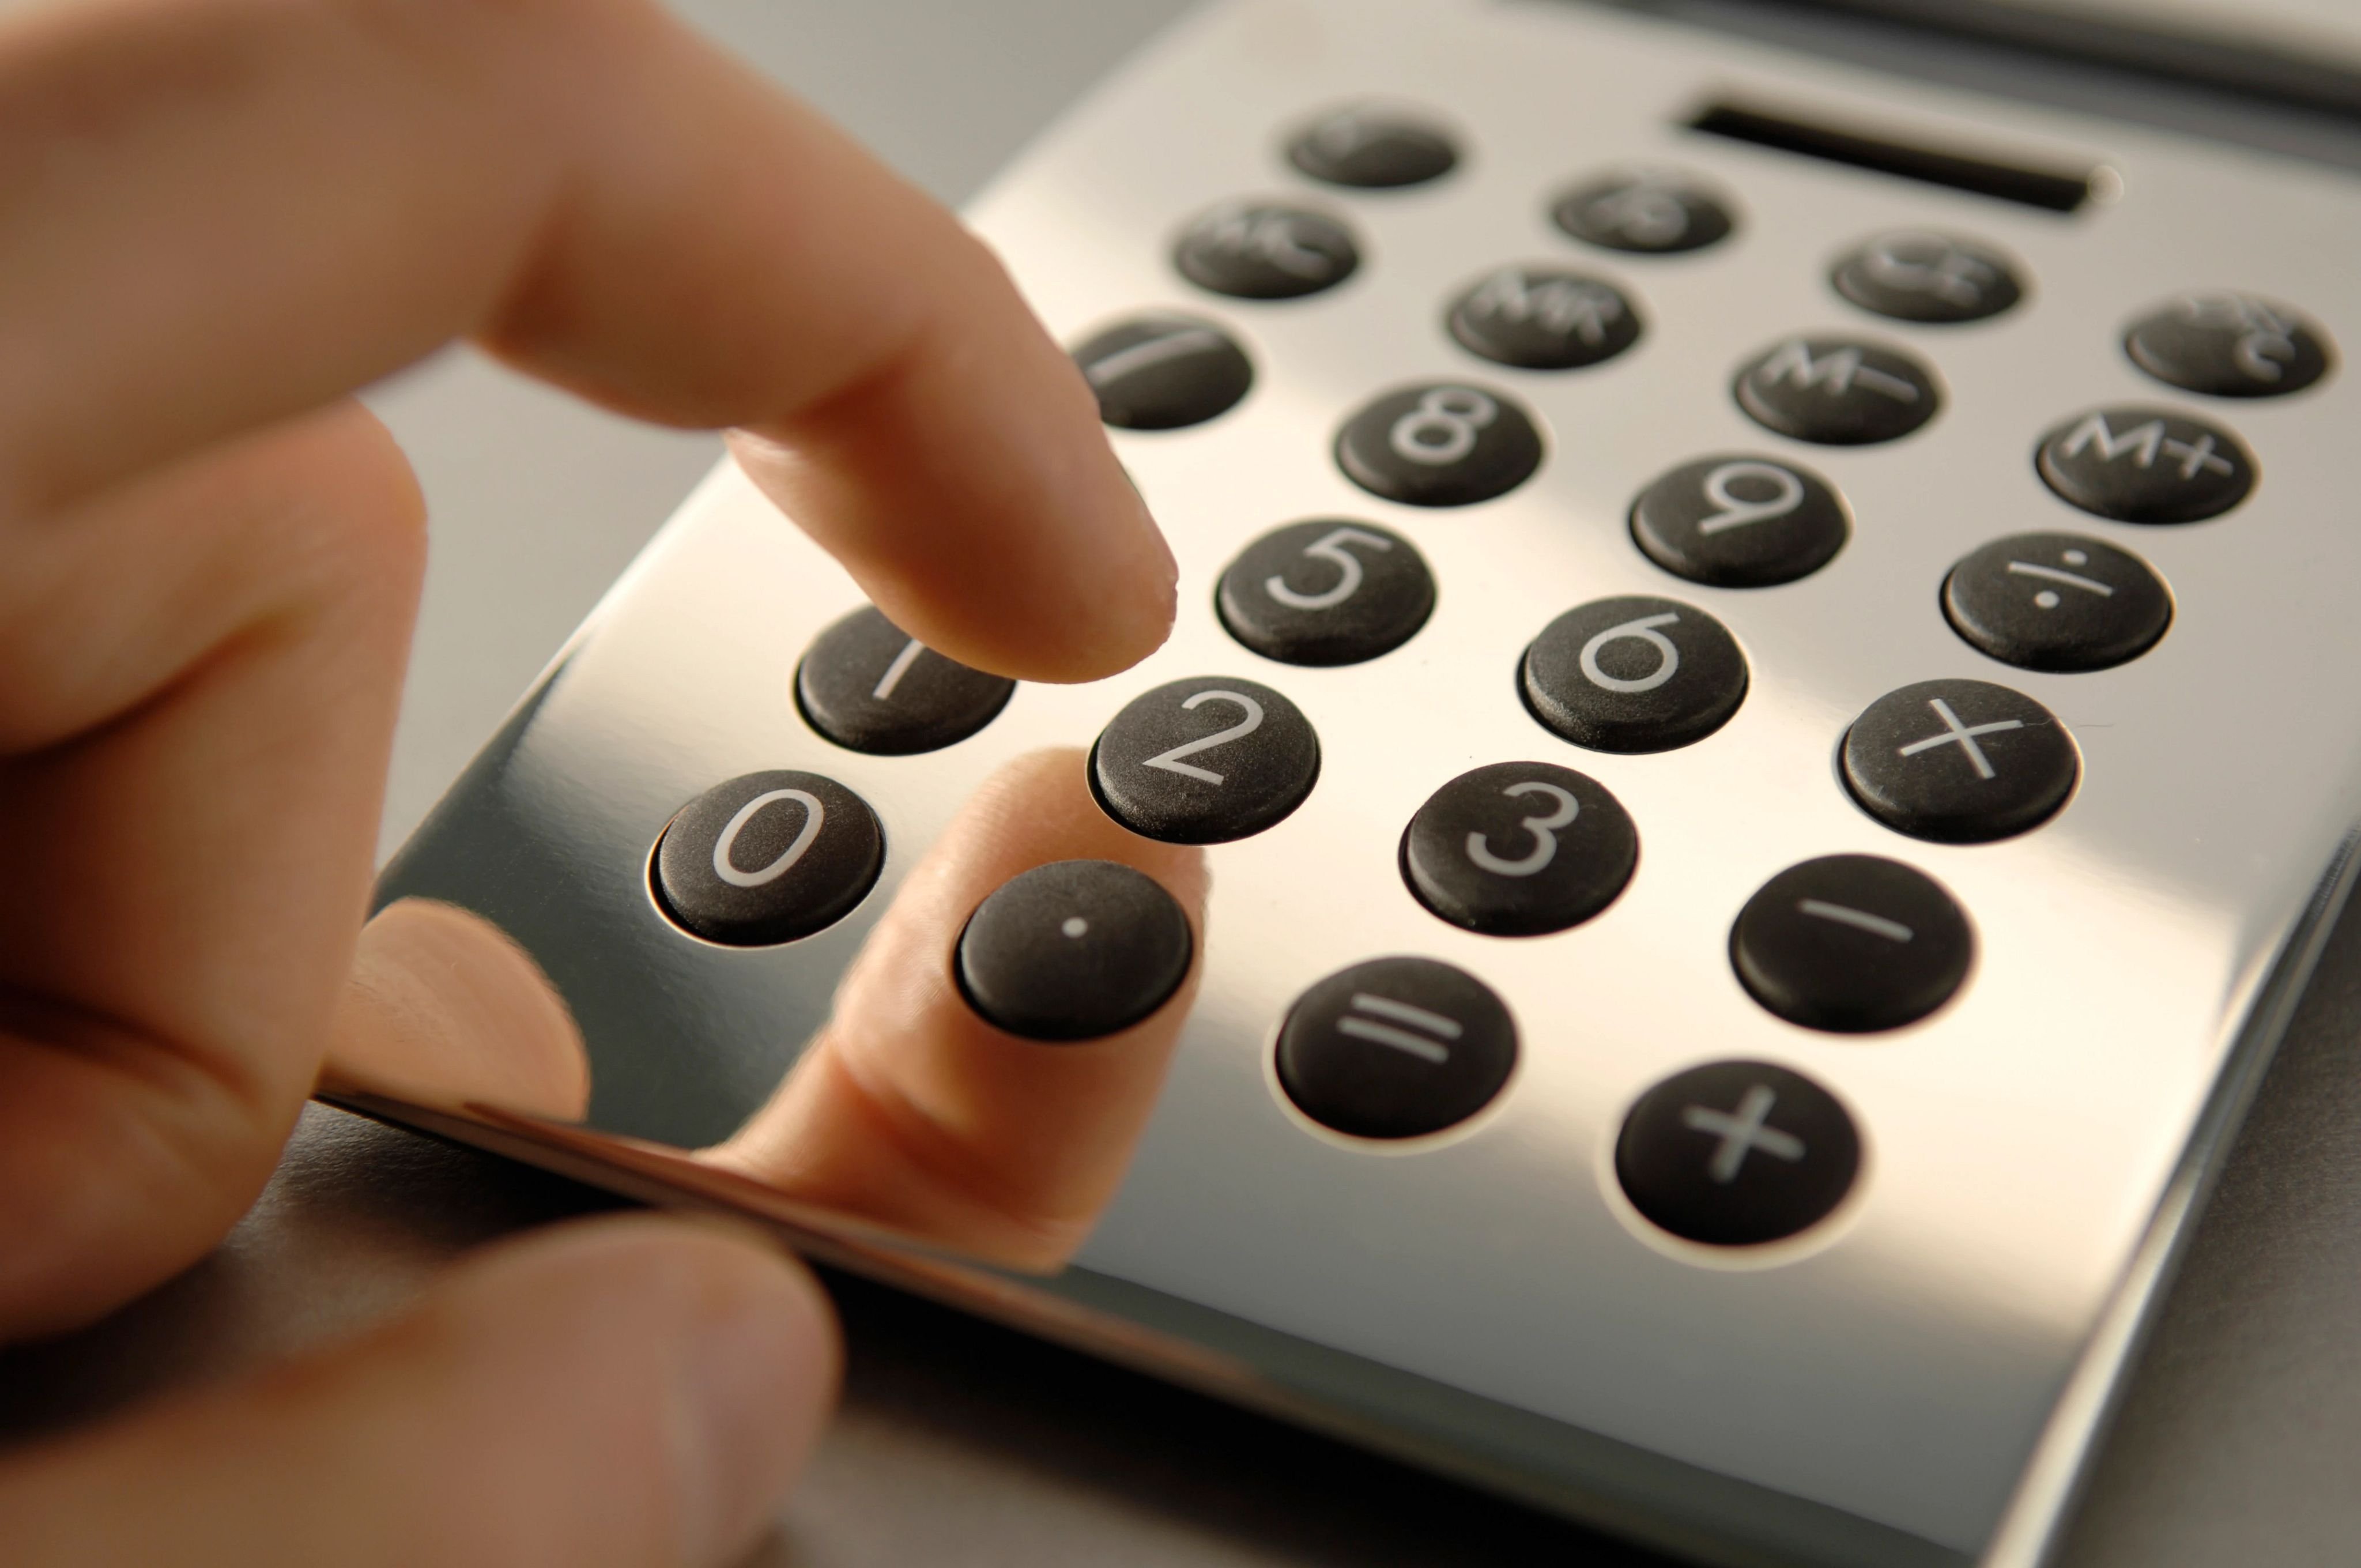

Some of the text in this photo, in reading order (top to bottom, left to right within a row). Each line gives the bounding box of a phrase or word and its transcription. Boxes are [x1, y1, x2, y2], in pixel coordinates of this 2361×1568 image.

[1388, 384, 1499, 463] 8
[2062, 412, 2235, 480] M+
[1699, 461, 1804, 536] 9
[1266, 525, 1393, 609] 5
[1580, 610, 1679, 692] 6
[1142, 689, 1264, 786] 2
[712, 787, 824, 888] 0
[1466, 781, 1579, 877] 3
[1683, 1082, 1805, 1183] +
